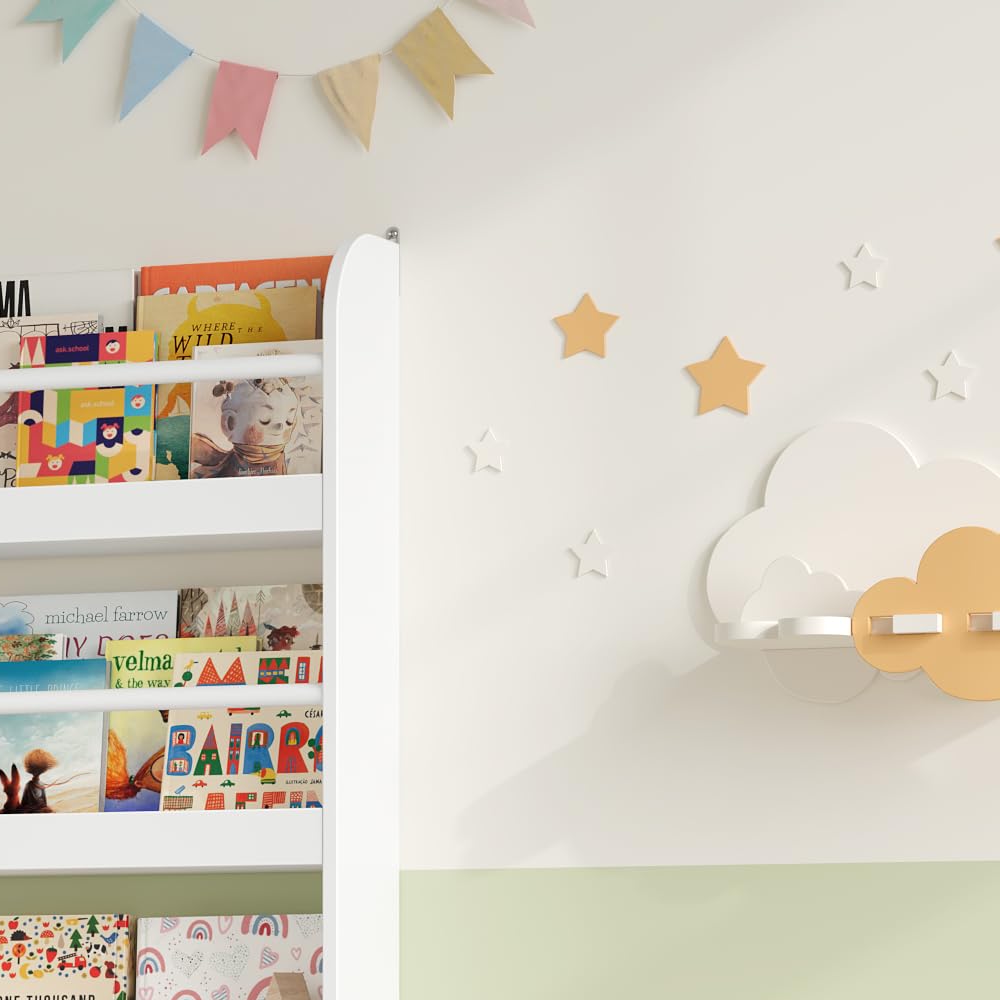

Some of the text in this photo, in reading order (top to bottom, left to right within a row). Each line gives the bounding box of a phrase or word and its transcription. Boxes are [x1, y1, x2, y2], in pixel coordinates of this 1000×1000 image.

[192, 322, 236, 332] WHERE
[55, 344, 90, 353] ask.school
[45, 606, 168, 625] michael farrow
[113, 650, 174, 672] velma
[128, 678, 143, 688] the
